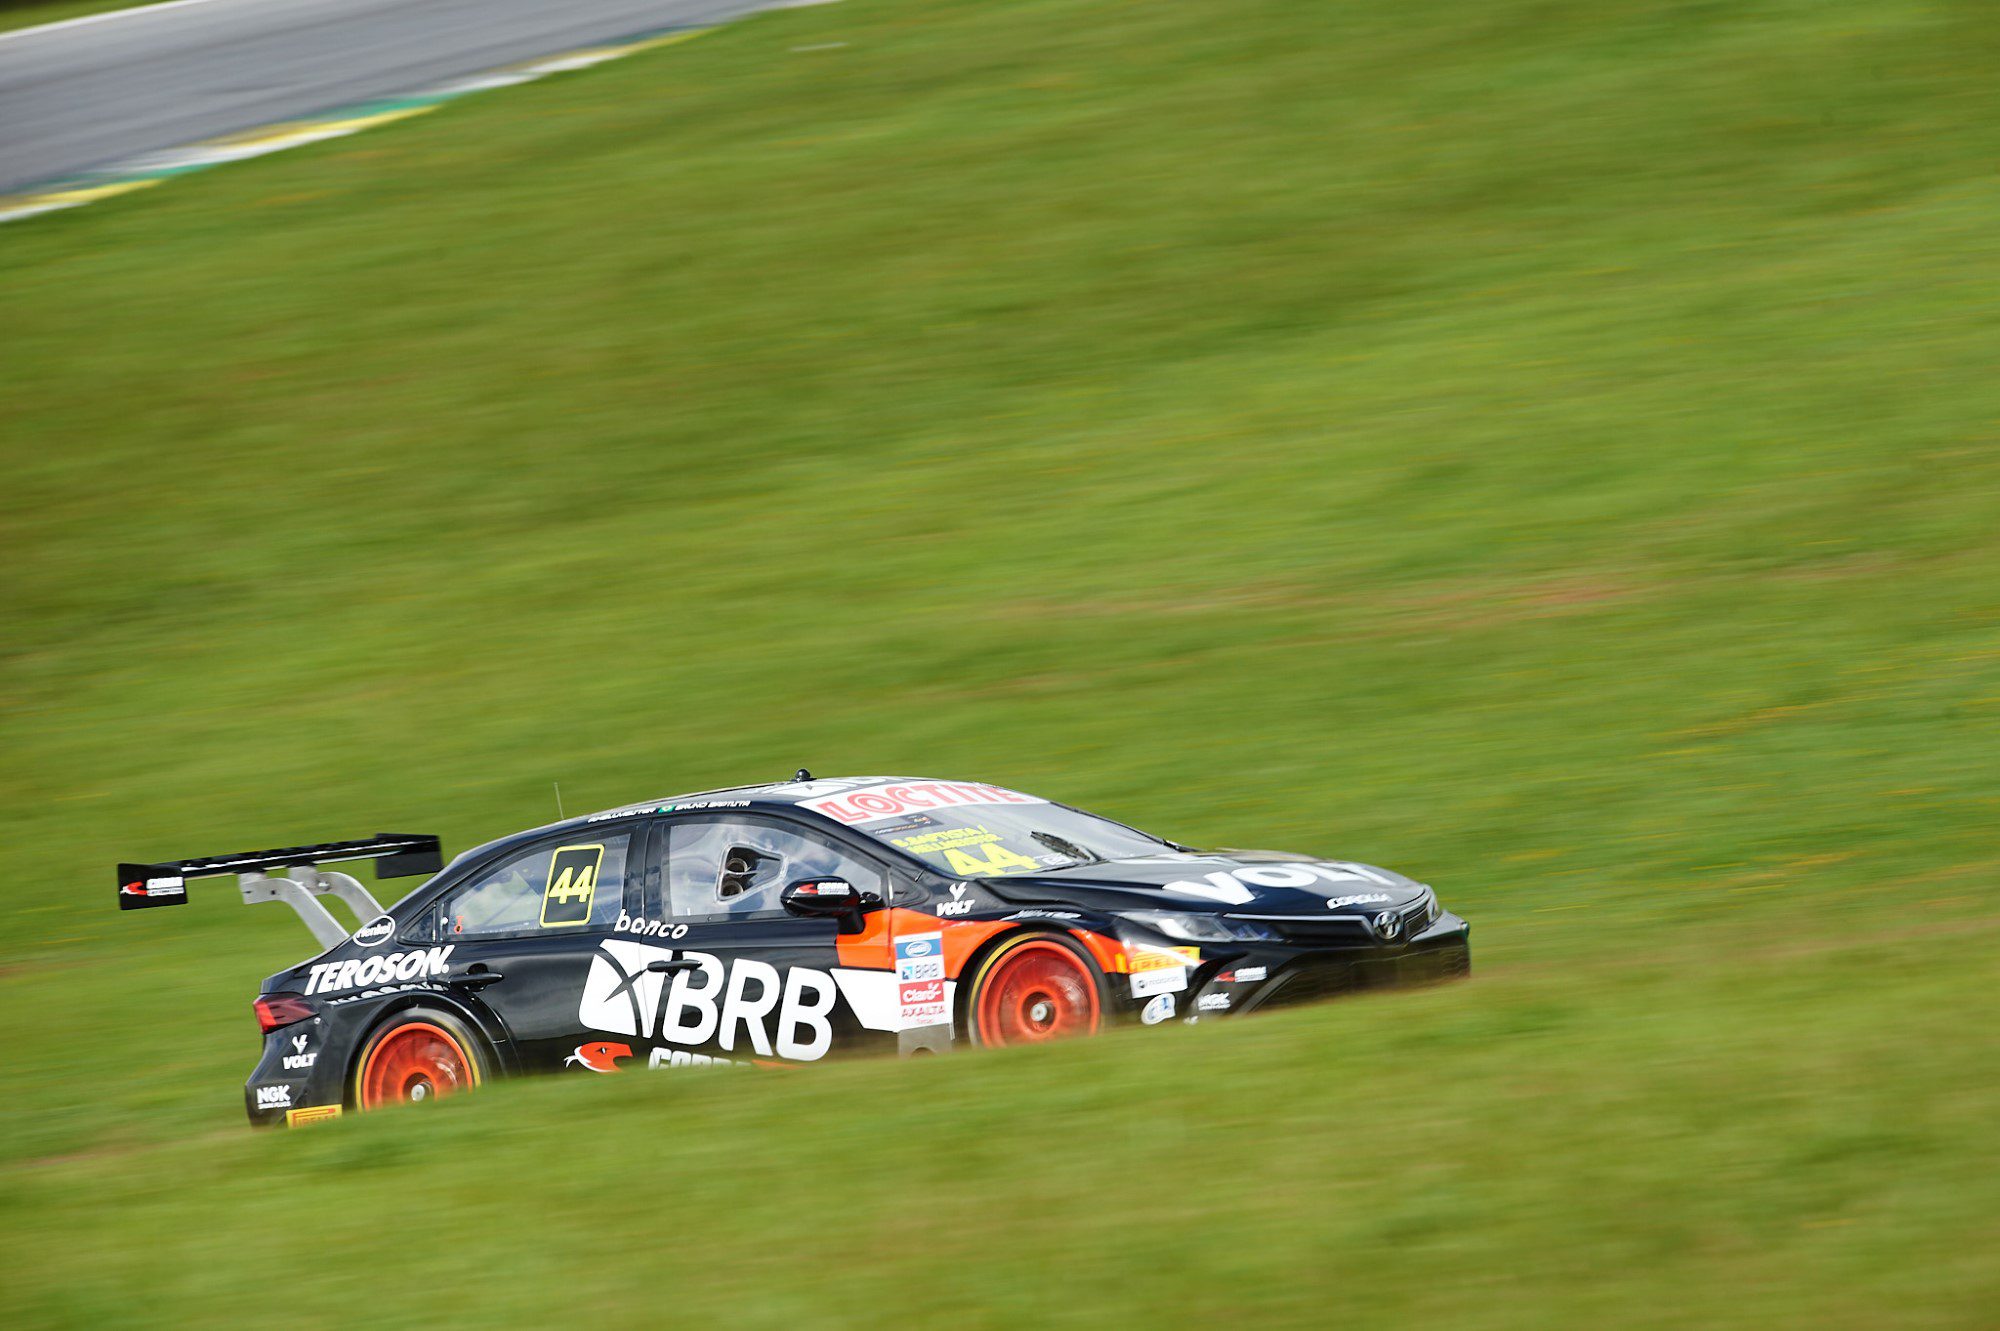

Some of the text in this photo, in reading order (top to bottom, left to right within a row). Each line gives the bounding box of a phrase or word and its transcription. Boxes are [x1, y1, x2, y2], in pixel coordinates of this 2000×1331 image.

[817, 784, 1026, 824] LOCTITE
[944, 843, 1041, 876] 44
[549, 865, 593, 904] 44
[1163, 862, 1396, 905] VOLT
[937, 899, 975, 916] VOLT
[614, 909, 689, 940] banco
[662, 951, 837, 1062] BRB
[903, 985, 941, 1003] Claro
[283, 1053, 317, 1070] VOLT
[257, 1085, 291, 1103] NGK
